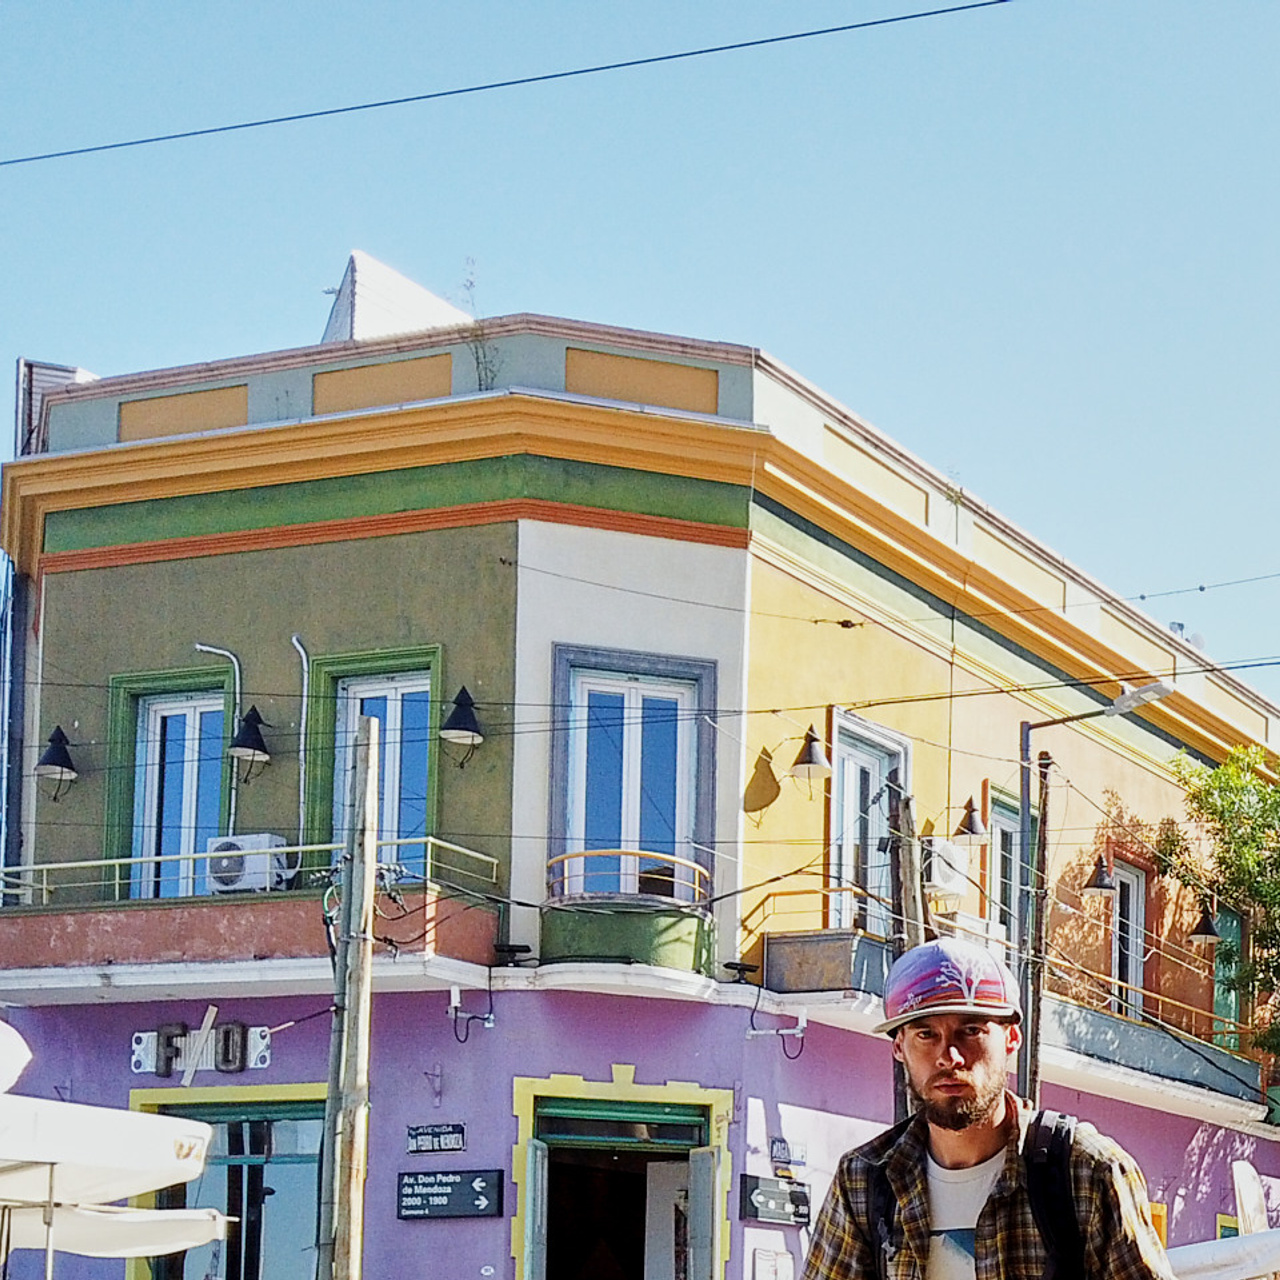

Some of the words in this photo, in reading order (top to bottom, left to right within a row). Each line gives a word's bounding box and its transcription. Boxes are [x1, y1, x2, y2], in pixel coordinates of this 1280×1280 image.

[403, 1175, 416, 1184] Av.
[418, 1175, 435, 1183] Don
[437, 1174, 461, 1183] Pedro
[402, 1186, 412, 1194] de
[414, 1185, 452, 1194] Mendoza
[402, 1197, 421, 1206] 2000
[429, 1196, 448, 1205] 1900
